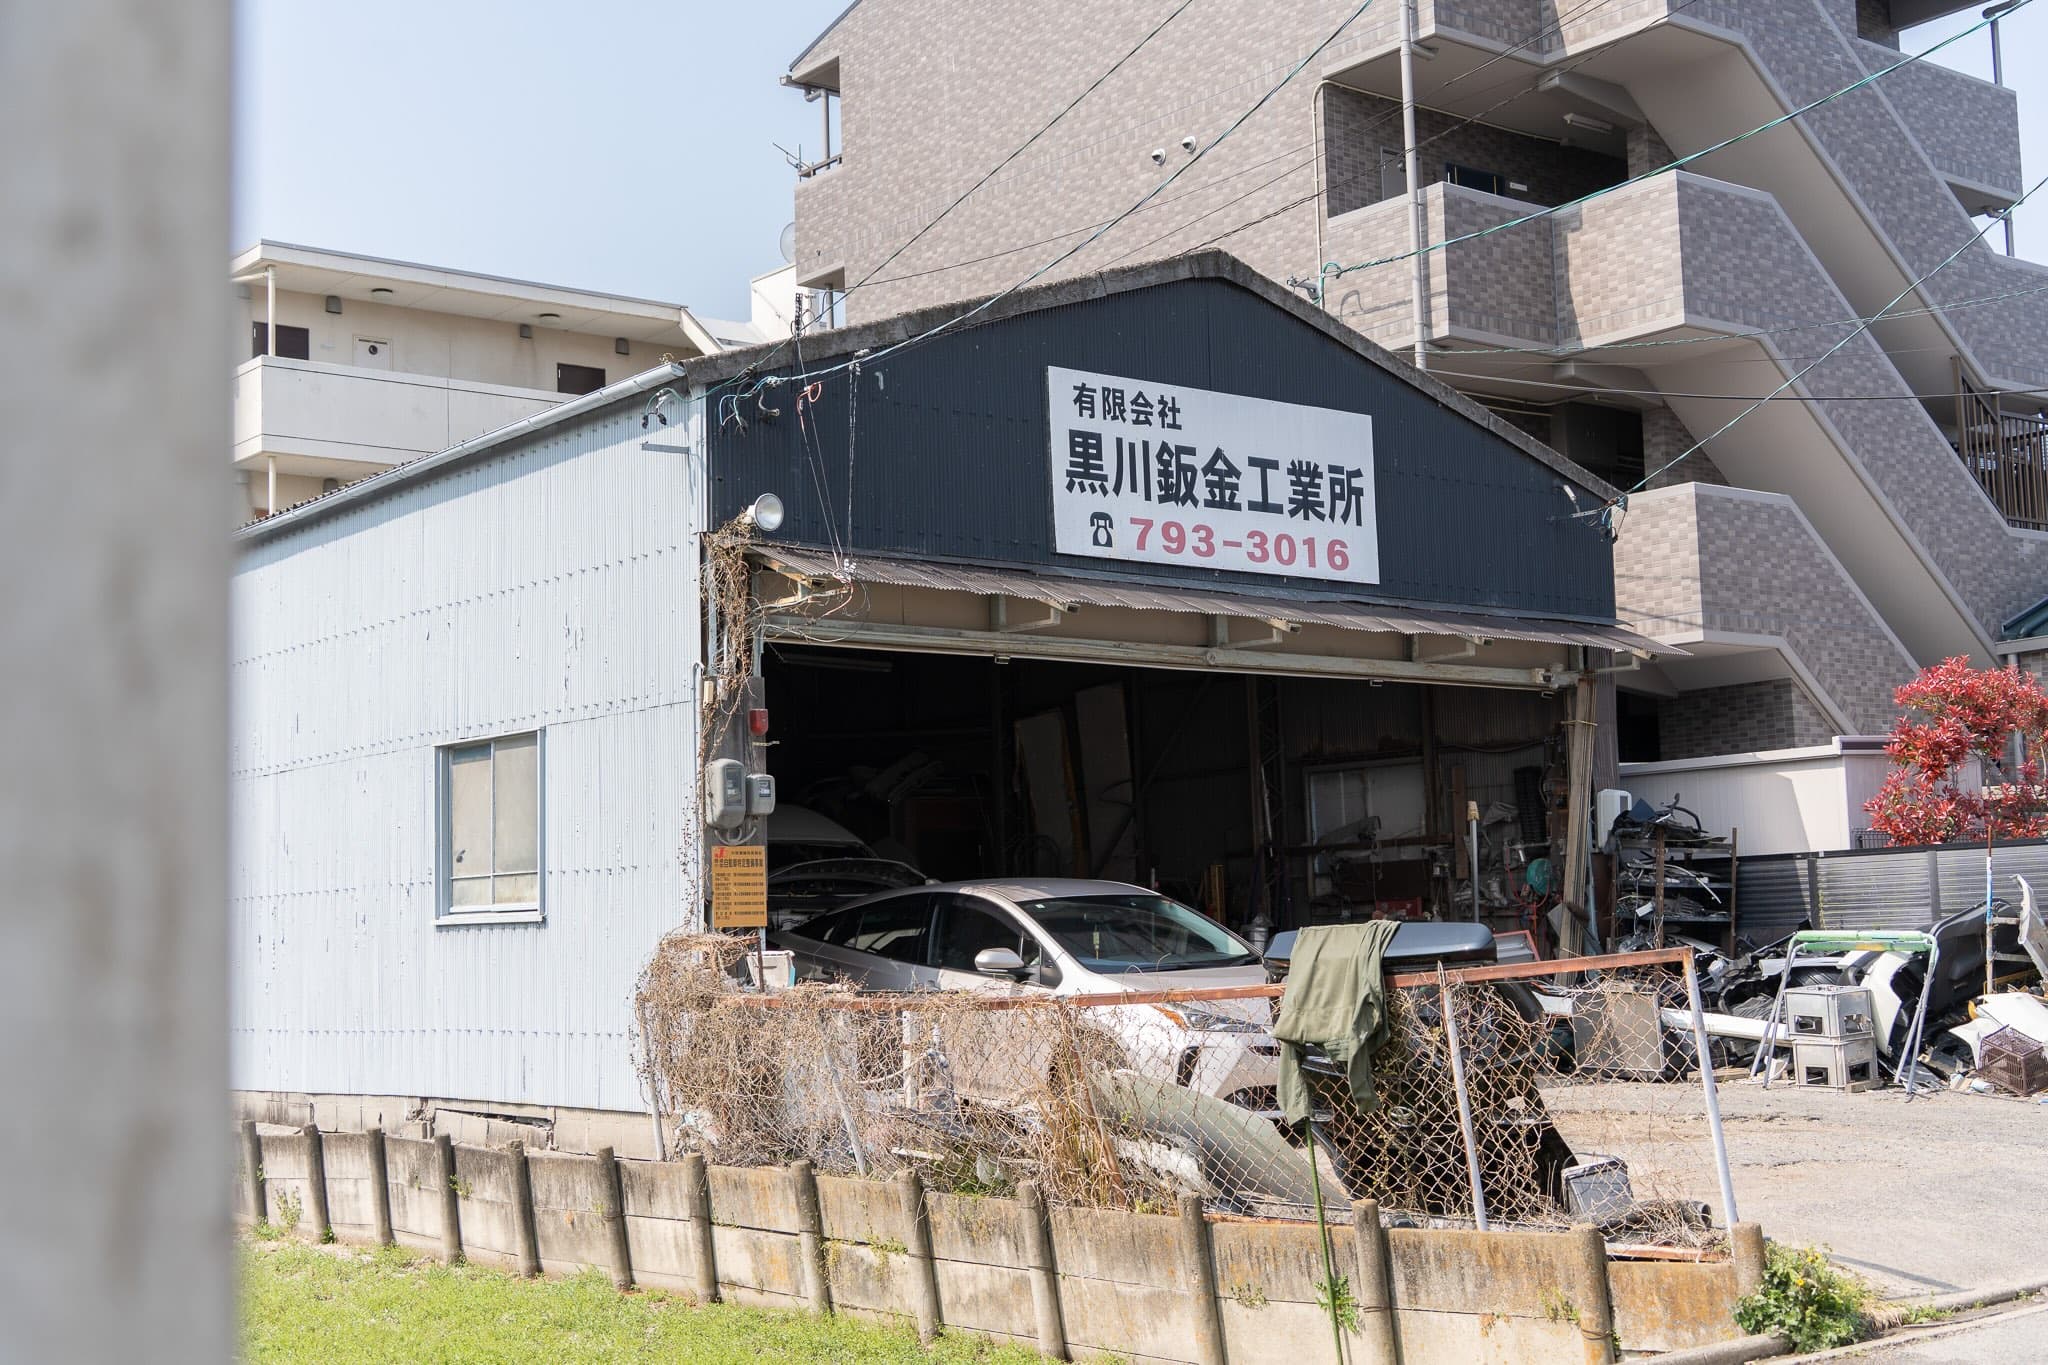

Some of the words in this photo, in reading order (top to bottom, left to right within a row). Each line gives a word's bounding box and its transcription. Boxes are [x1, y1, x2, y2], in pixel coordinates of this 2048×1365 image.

[1073, 382, 1182, 430] 有限会社
[1065, 428, 1364, 527] 黒川鈑金工業所
[1130, 517, 1349, 571] 793-3016
